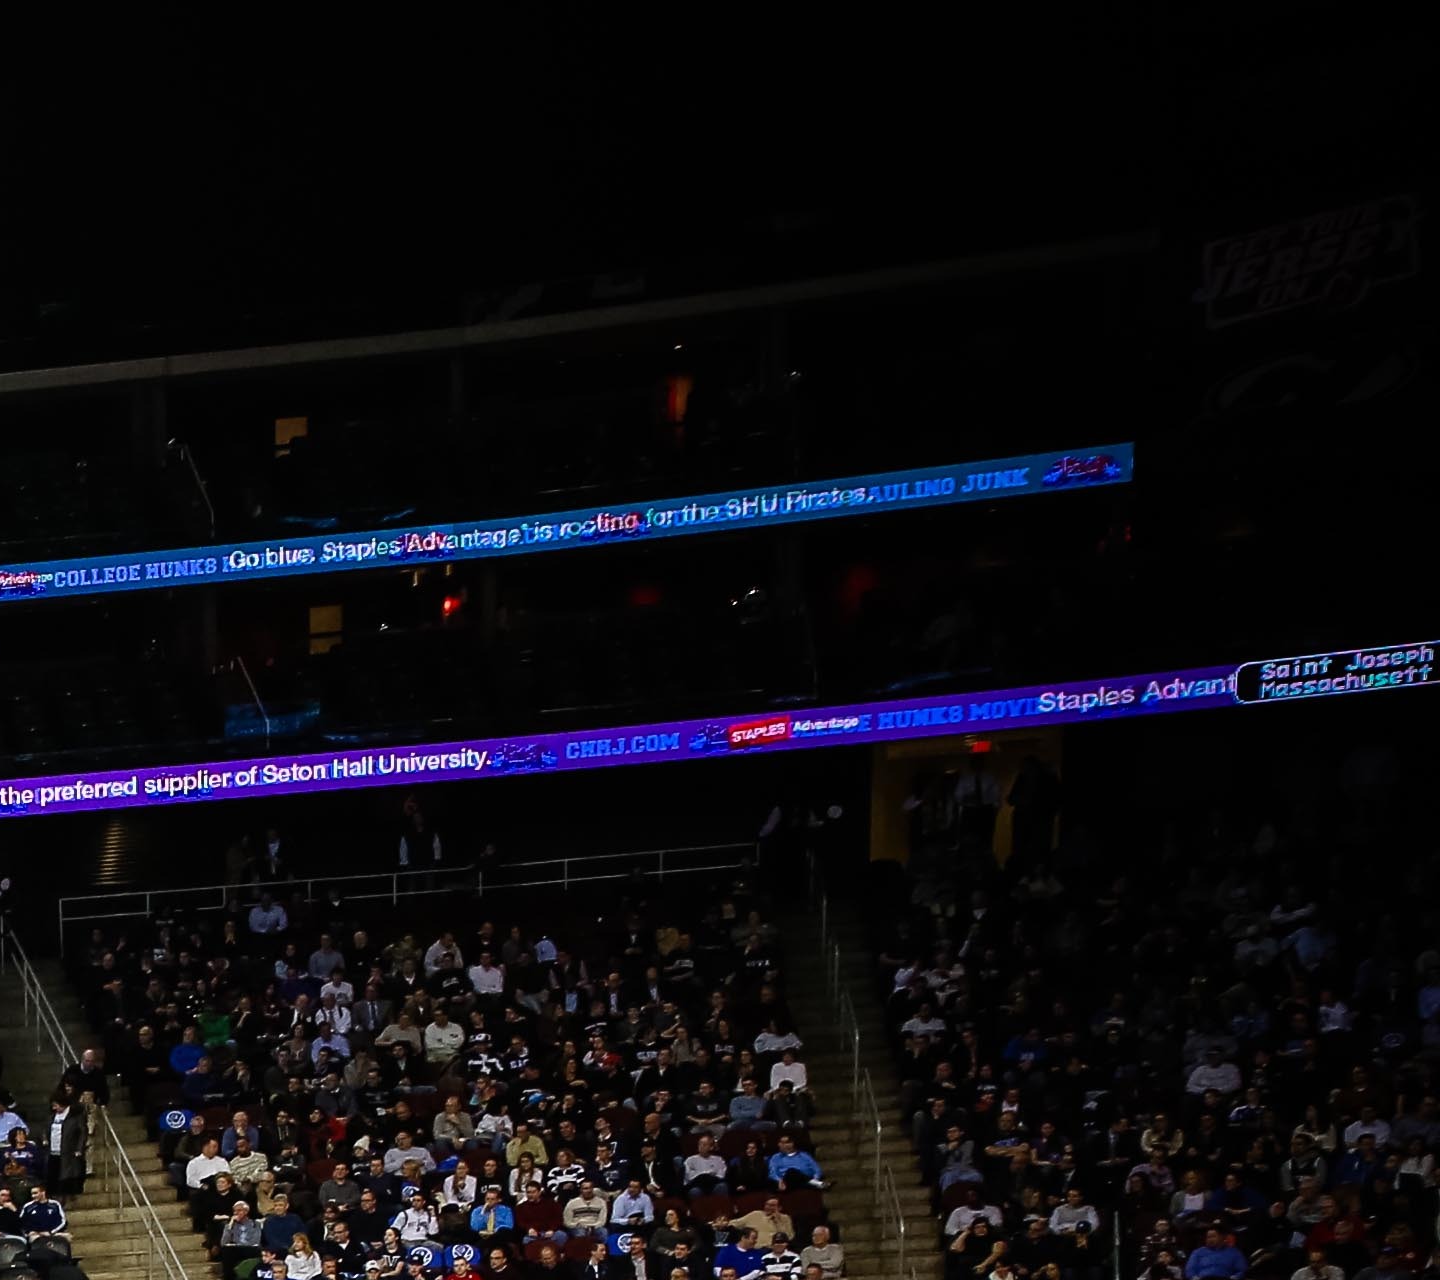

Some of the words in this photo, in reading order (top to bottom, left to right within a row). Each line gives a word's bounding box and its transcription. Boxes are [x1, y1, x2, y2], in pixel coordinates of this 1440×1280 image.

[960, 468, 1030, 492] JUNK
[322, 537, 402, 561] Staples
[681, 502, 720, 522] the
[726, 495, 777, 517] SHU
[1260, 657, 1333, 680] Saint
[1344, 645, 1434, 672] Joseph
[1038, 688, 1135, 716] Staples
[731, 722, 786, 742] STAPLES
[0, 785, 35, 806] the
[40, 777, 137, 806] preferred
[144, 768, 232, 796] supplier
[234, 765, 258, 786] of
[262, 761, 326, 784] Seton
[333, 756, 373, 778] Hall
[378, 746, 492, 775] University.
